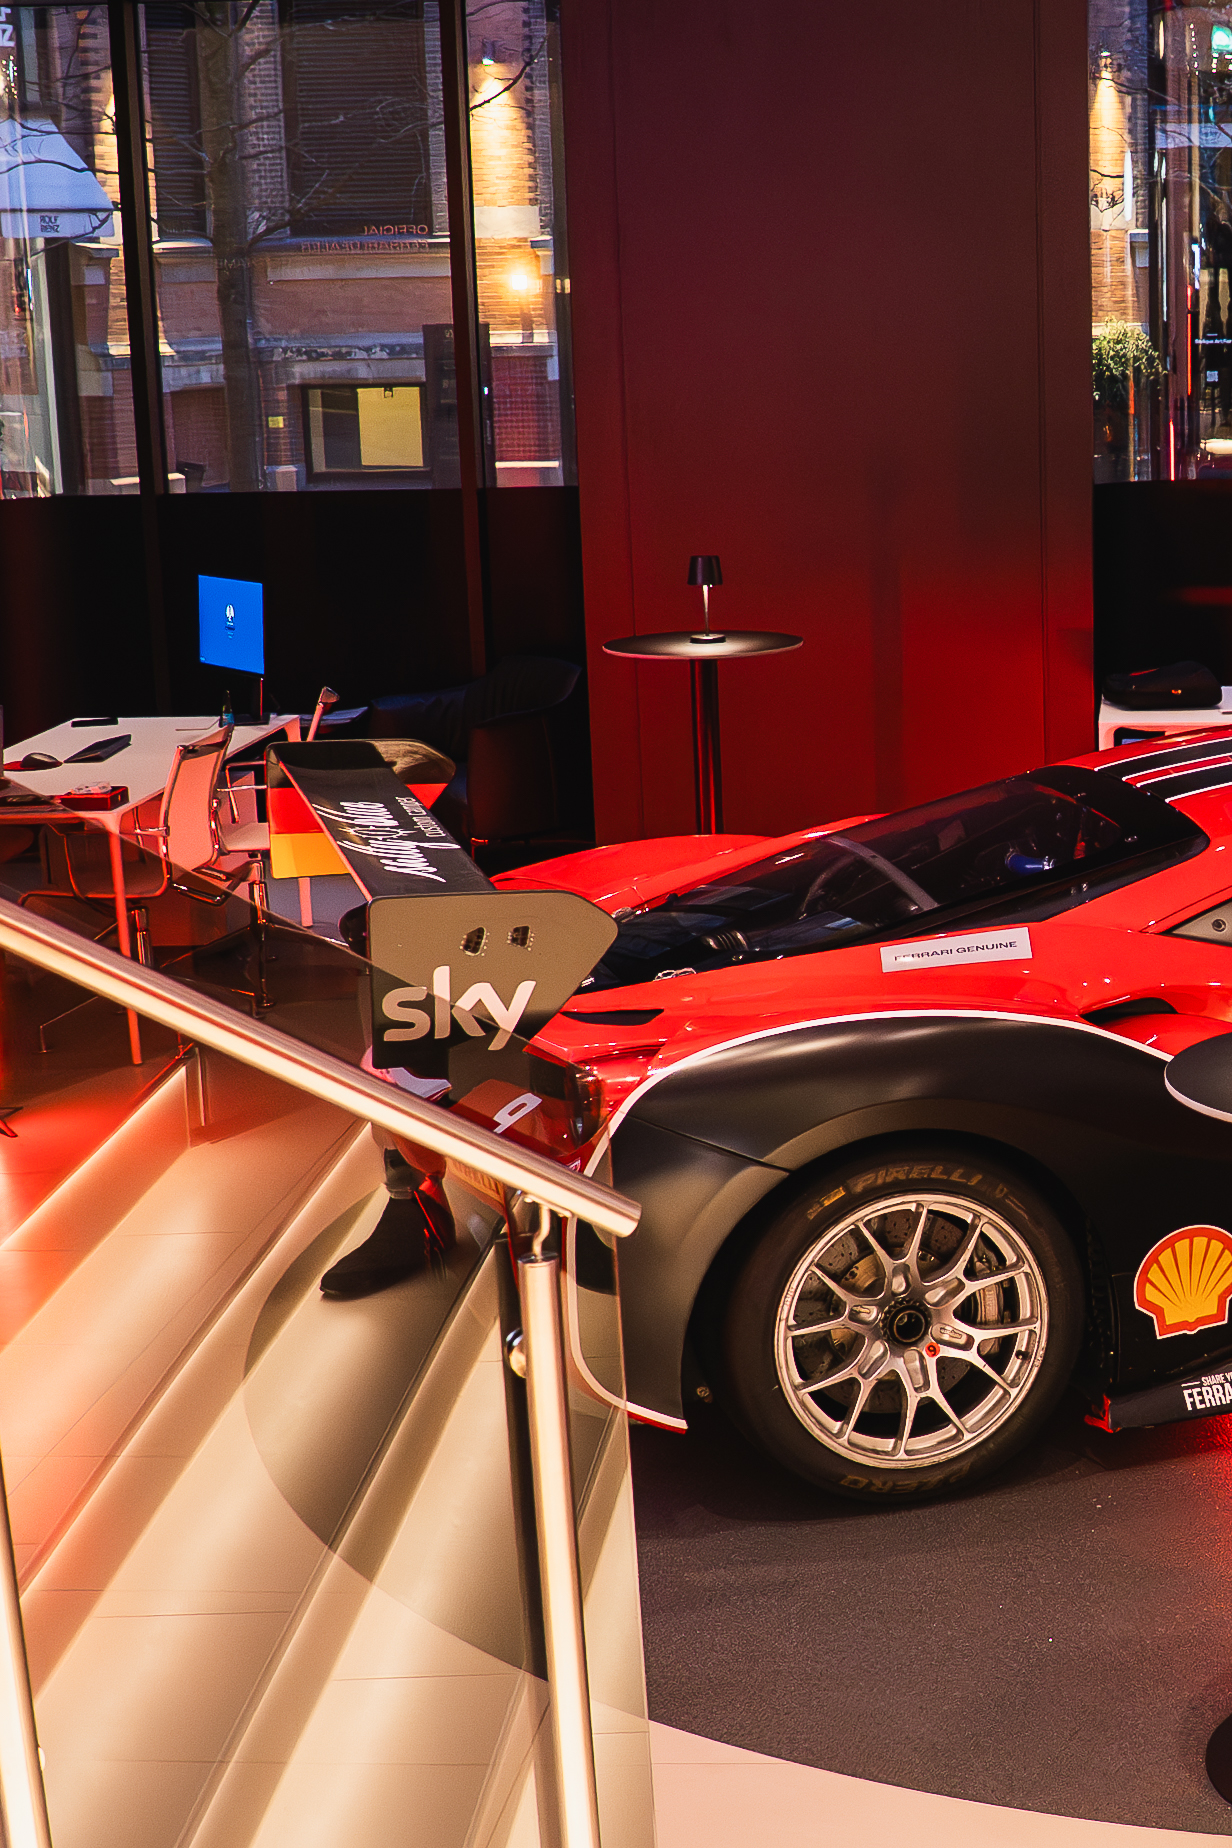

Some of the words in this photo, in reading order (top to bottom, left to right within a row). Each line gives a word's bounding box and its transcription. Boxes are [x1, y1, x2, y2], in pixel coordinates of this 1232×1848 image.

[956, 941, 1018, 954] GENUINE
[382, 965, 537, 1050] sky
[1201, 1373, 1226, 1386] SHARE
